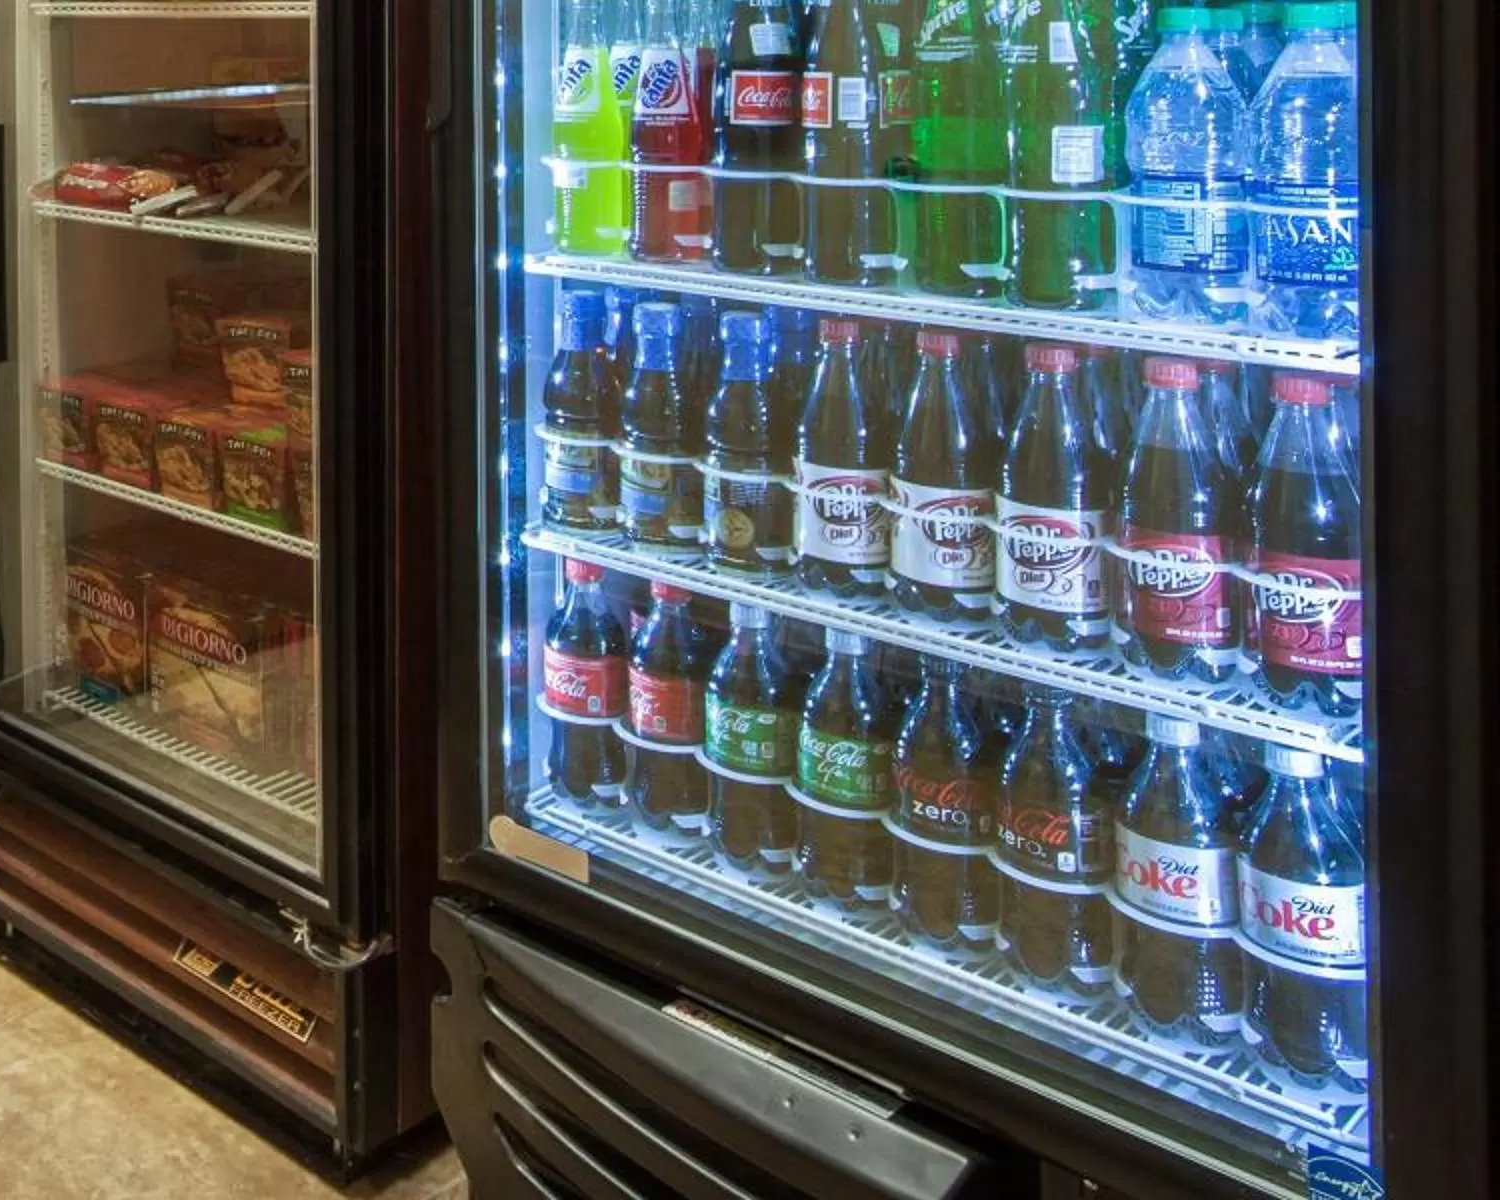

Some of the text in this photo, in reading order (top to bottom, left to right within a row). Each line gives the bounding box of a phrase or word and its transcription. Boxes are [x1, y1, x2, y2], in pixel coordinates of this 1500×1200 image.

[1264, 214, 1353, 247] ASAN
[1019, 573, 1045, 589] Diet
[162, 615, 248, 666] DIGIORNO
[912, 799, 968, 826] zero
[1122, 858, 1198, 899] oke
[1156, 855, 1200, 876] Diet
[1292, 895, 1337, 917] Diet
